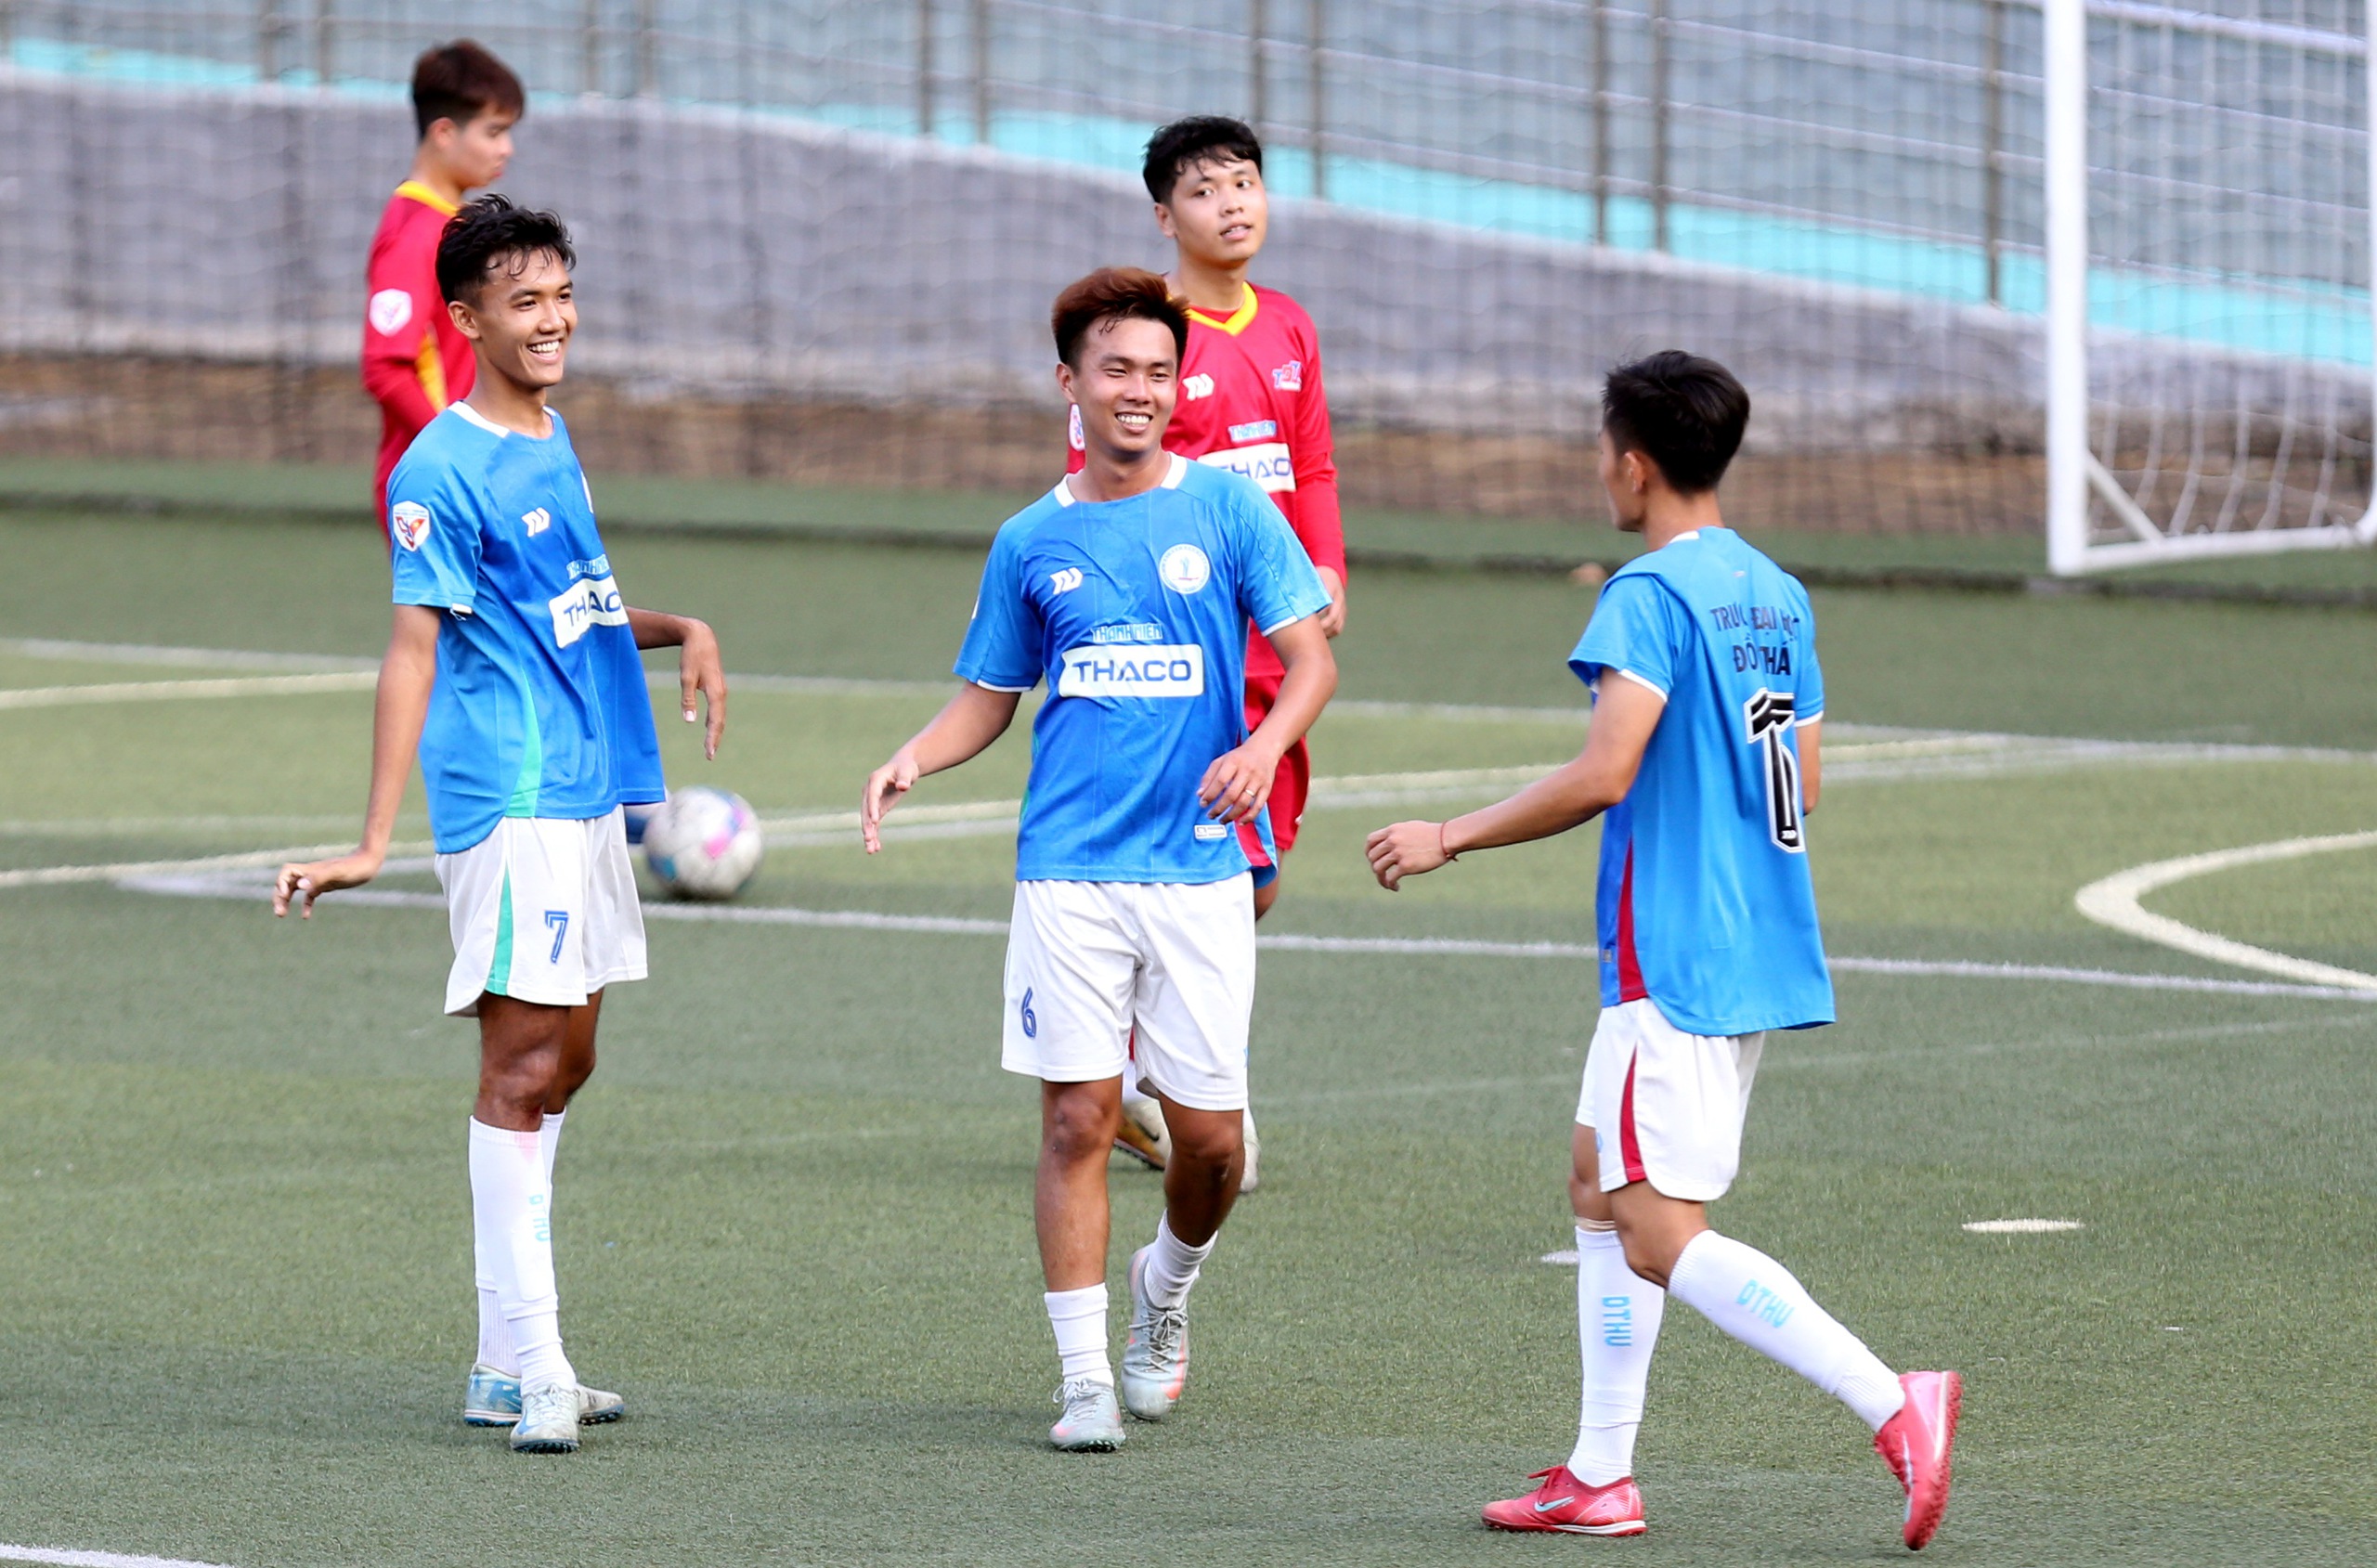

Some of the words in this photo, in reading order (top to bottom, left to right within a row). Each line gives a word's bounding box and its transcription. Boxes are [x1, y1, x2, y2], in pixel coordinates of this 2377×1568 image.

[1072, 659, 1192, 683] THACO
[544, 910, 569, 964] 7
[1021, 987, 1037, 1039] 6
[1602, 1296, 1632, 1347] DTHU
[1737, 1279, 1795, 1328] DTHU
